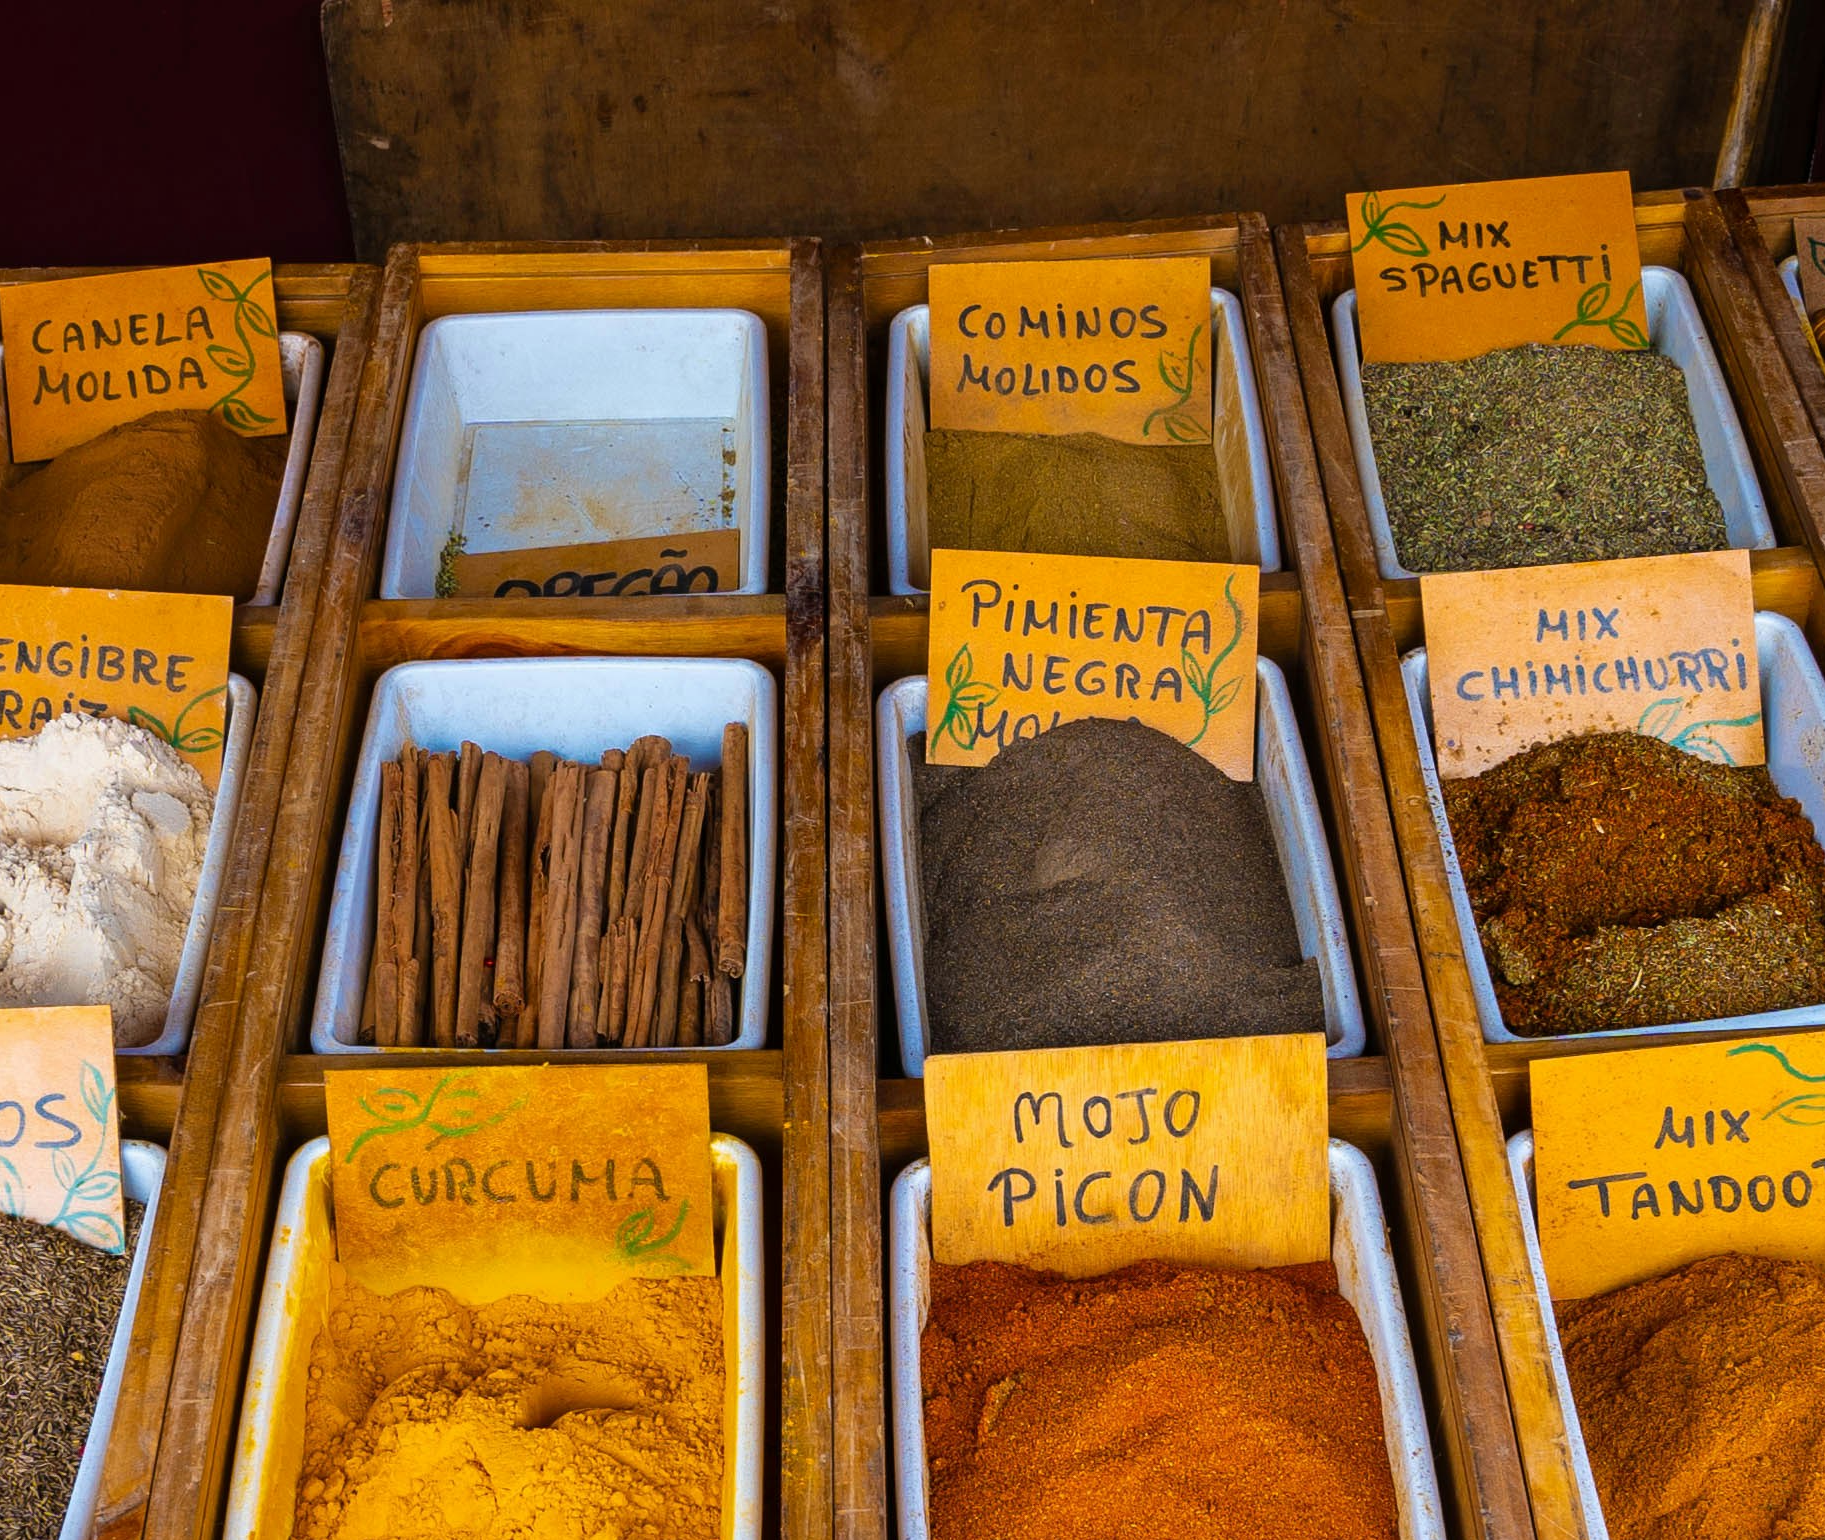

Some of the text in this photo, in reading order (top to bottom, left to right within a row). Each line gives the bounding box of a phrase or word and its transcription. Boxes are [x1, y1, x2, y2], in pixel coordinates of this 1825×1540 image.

[1438, 221, 1512, 252] MIX
[1380, 244, 1613, 293] SPAGUETTI
[32, 306, 215, 357] CANELA
[958, 303, 1169, 342] COMINOS
[33, 356, 209, 406] MOLIDA
[958, 354, 1142, 397] MOLIDOS
[961, 578, 1213, 656] PIMIENTA
[1537, 606, 1620, 643] MIX
[1001, 652, 1185, 703] NEGRA
[1456, 638, 1748, 701] CHIMICHURRI
[1014, 1088, 1201, 1149] MOJO
[1654, 1104, 1752, 1150] MIX
[987, 1164, 1219, 1227] PICON
